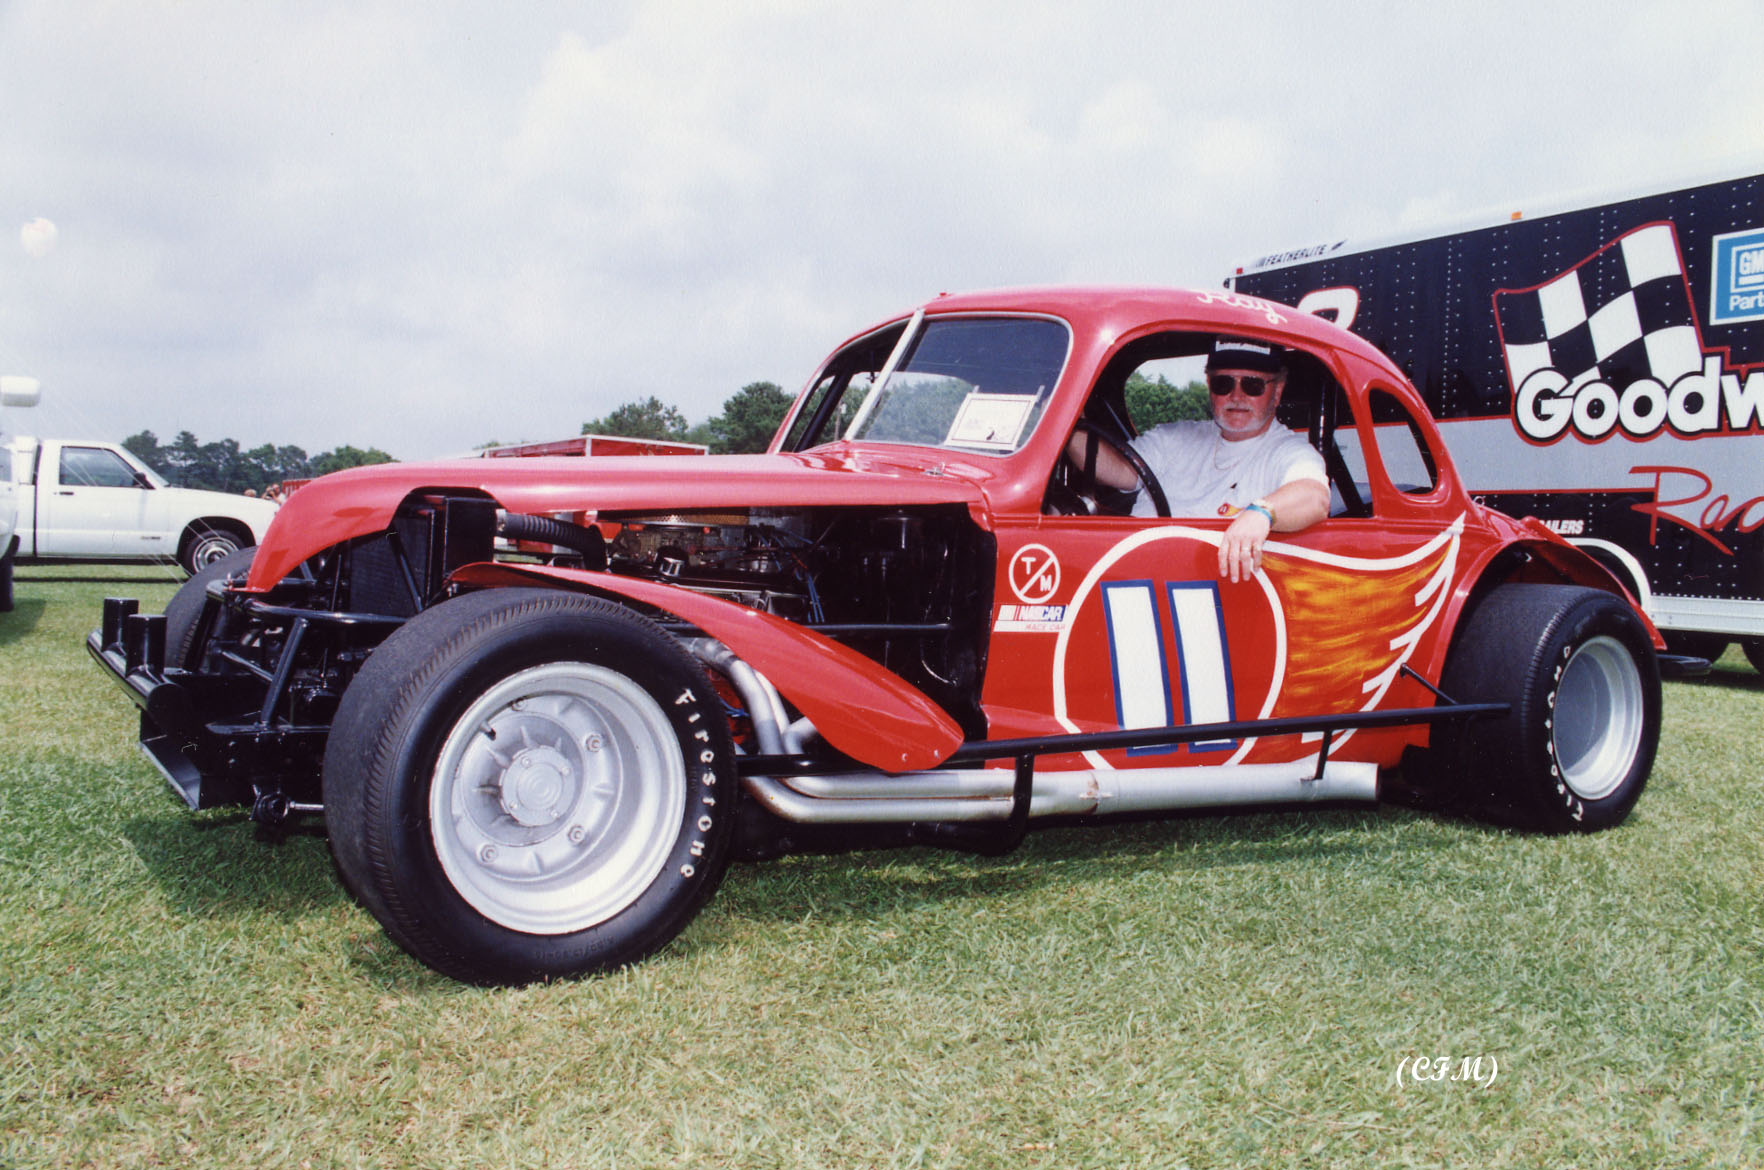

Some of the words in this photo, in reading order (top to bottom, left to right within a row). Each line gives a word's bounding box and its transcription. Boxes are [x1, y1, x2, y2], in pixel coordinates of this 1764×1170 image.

[1265, 244, 1327, 266] FEATHERLITE
[1018, 605, 1064, 621] NASCAR
[675, 688, 716, 878] Firestone
